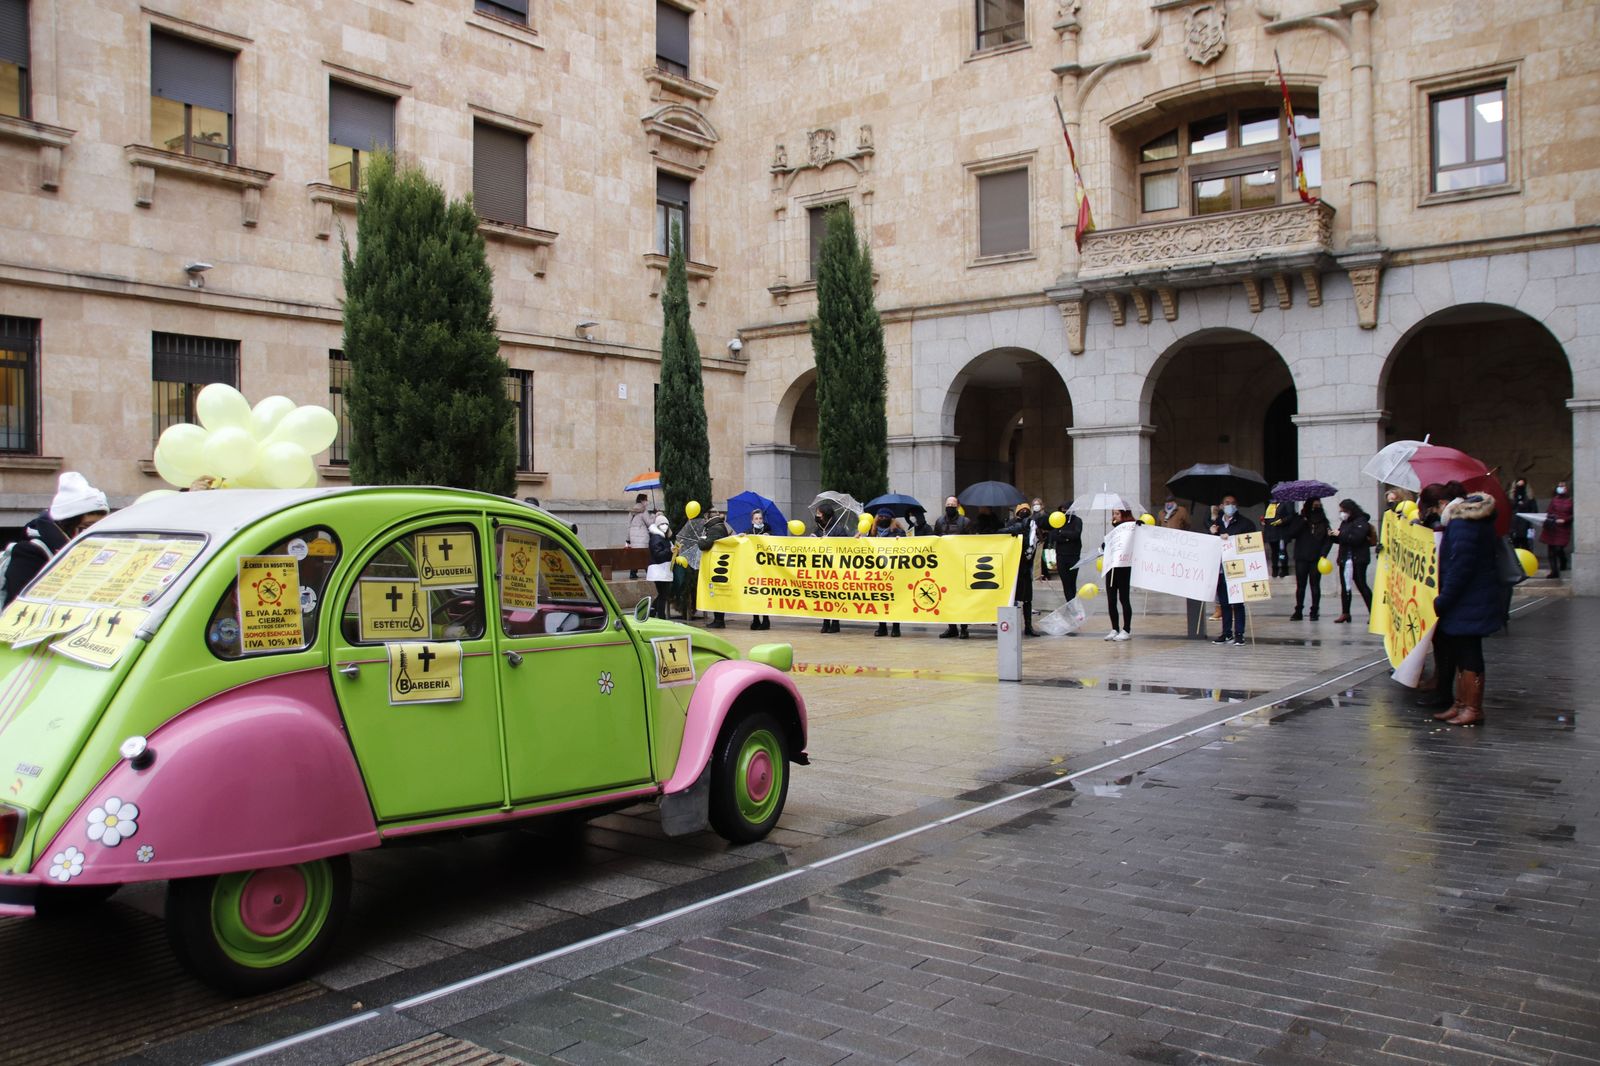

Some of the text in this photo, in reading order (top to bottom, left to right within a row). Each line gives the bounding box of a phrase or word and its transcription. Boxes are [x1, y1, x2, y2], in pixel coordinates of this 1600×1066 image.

[756, 544, 937, 554] PLATAFORMA DE IMAGEN PERSONAL
[755, 552, 939, 570] CREER EN NOSOTROS
[424, 565, 472, 577] PELUQUERÍA
[797, 569, 895, 582] EL IVA AL 21%
[748, 577, 893, 592] CIERRA NUESTROS CENTROS
[743, 586, 801, 597] ¡SOMOS
[804, 589, 895, 602] ESENCIALES!
[283, 608, 297, 616] 21%
[779, 598, 808, 610] IVA
[813, 600, 848, 614] 10%
[853, 602, 878, 615] YA
[258, 616, 286, 624] CIERRA
[373, 617, 423, 629] ESTÉTICA
[268, 639, 285, 647] 10%
[399, 678, 451, 691] BARBERÍA
